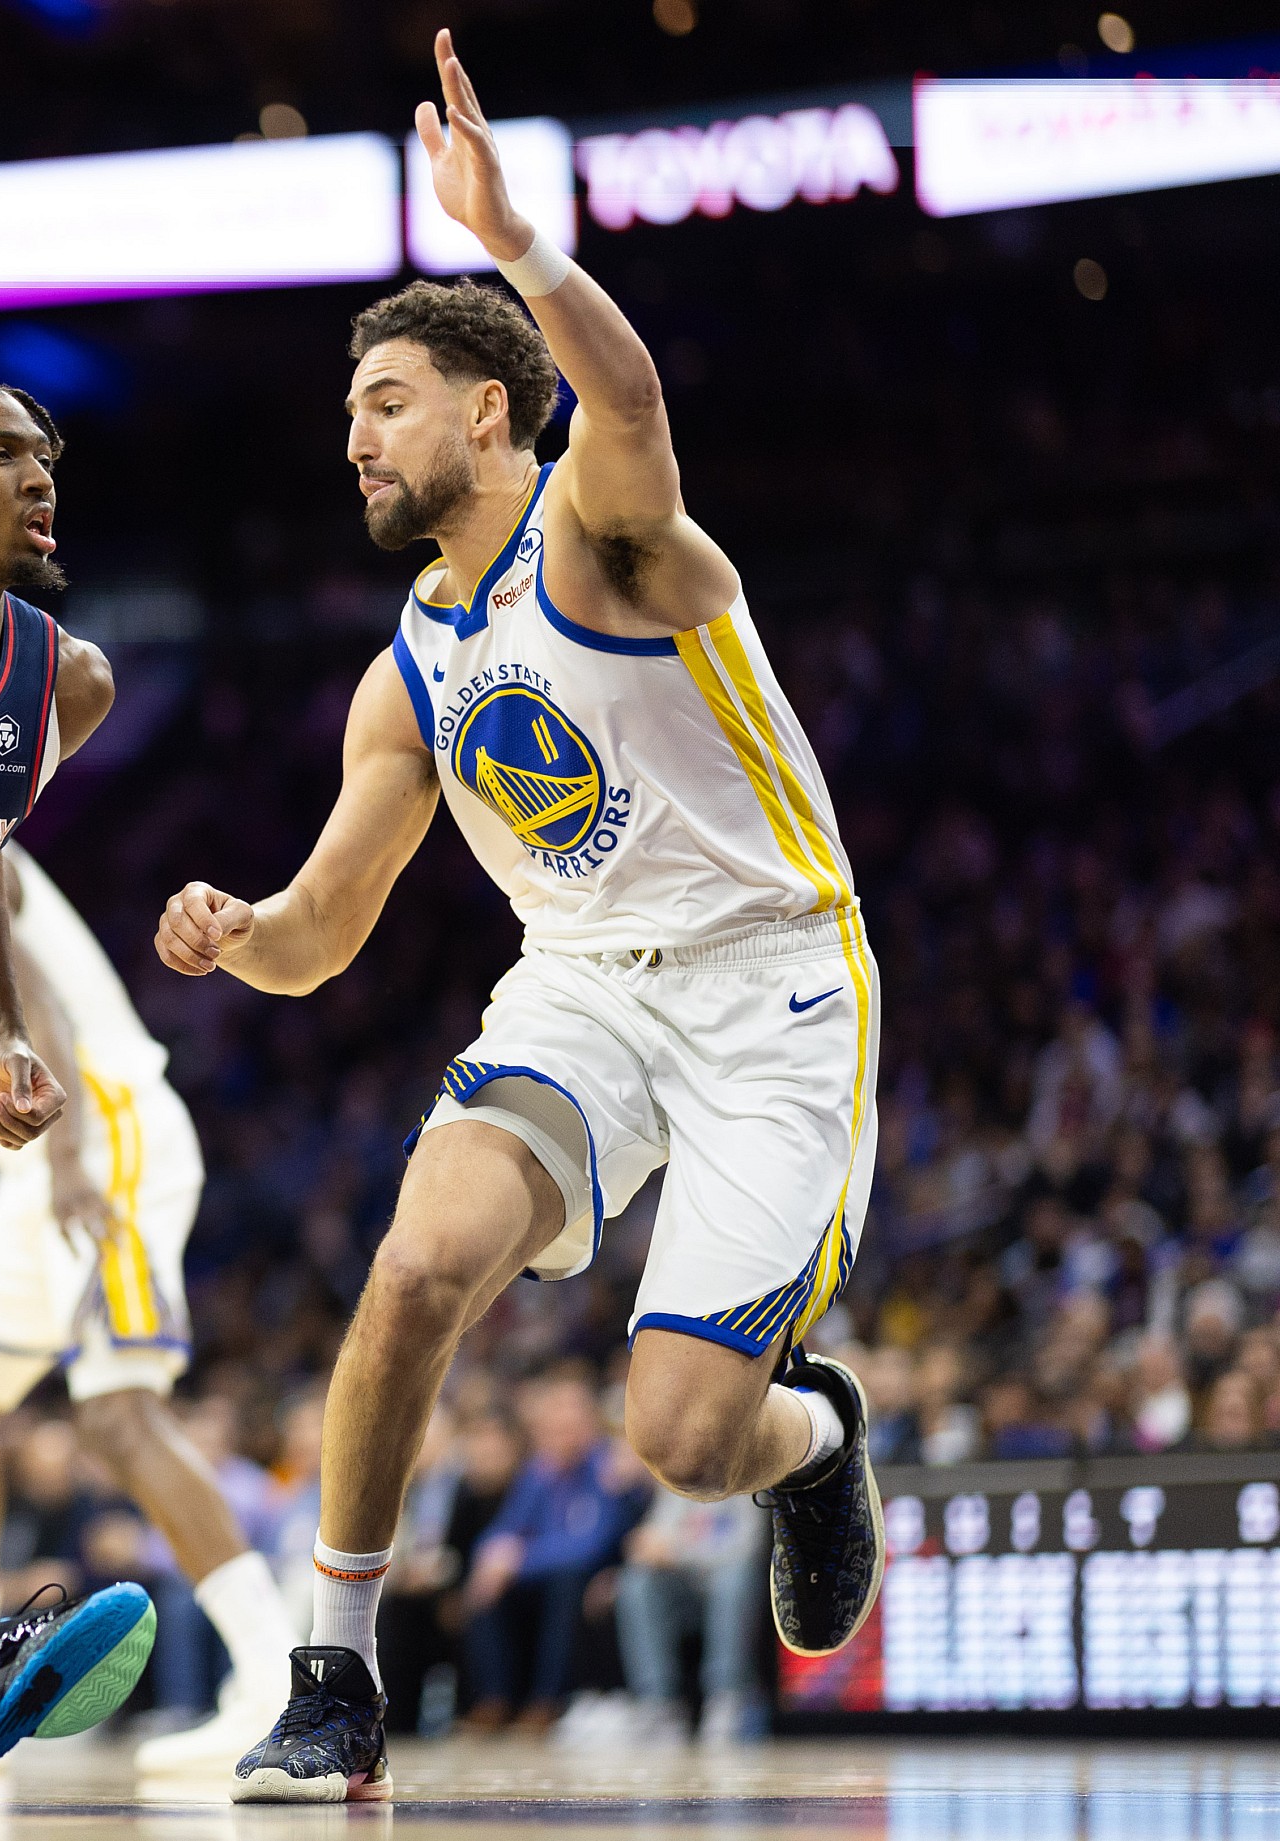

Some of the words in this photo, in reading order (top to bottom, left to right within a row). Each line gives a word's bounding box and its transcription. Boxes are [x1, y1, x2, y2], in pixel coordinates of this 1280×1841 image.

[492, 573, 534, 609] Rakuten
[436, 668, 494, 751] GOLDEN
[498, 663, 553, 696] STATE
